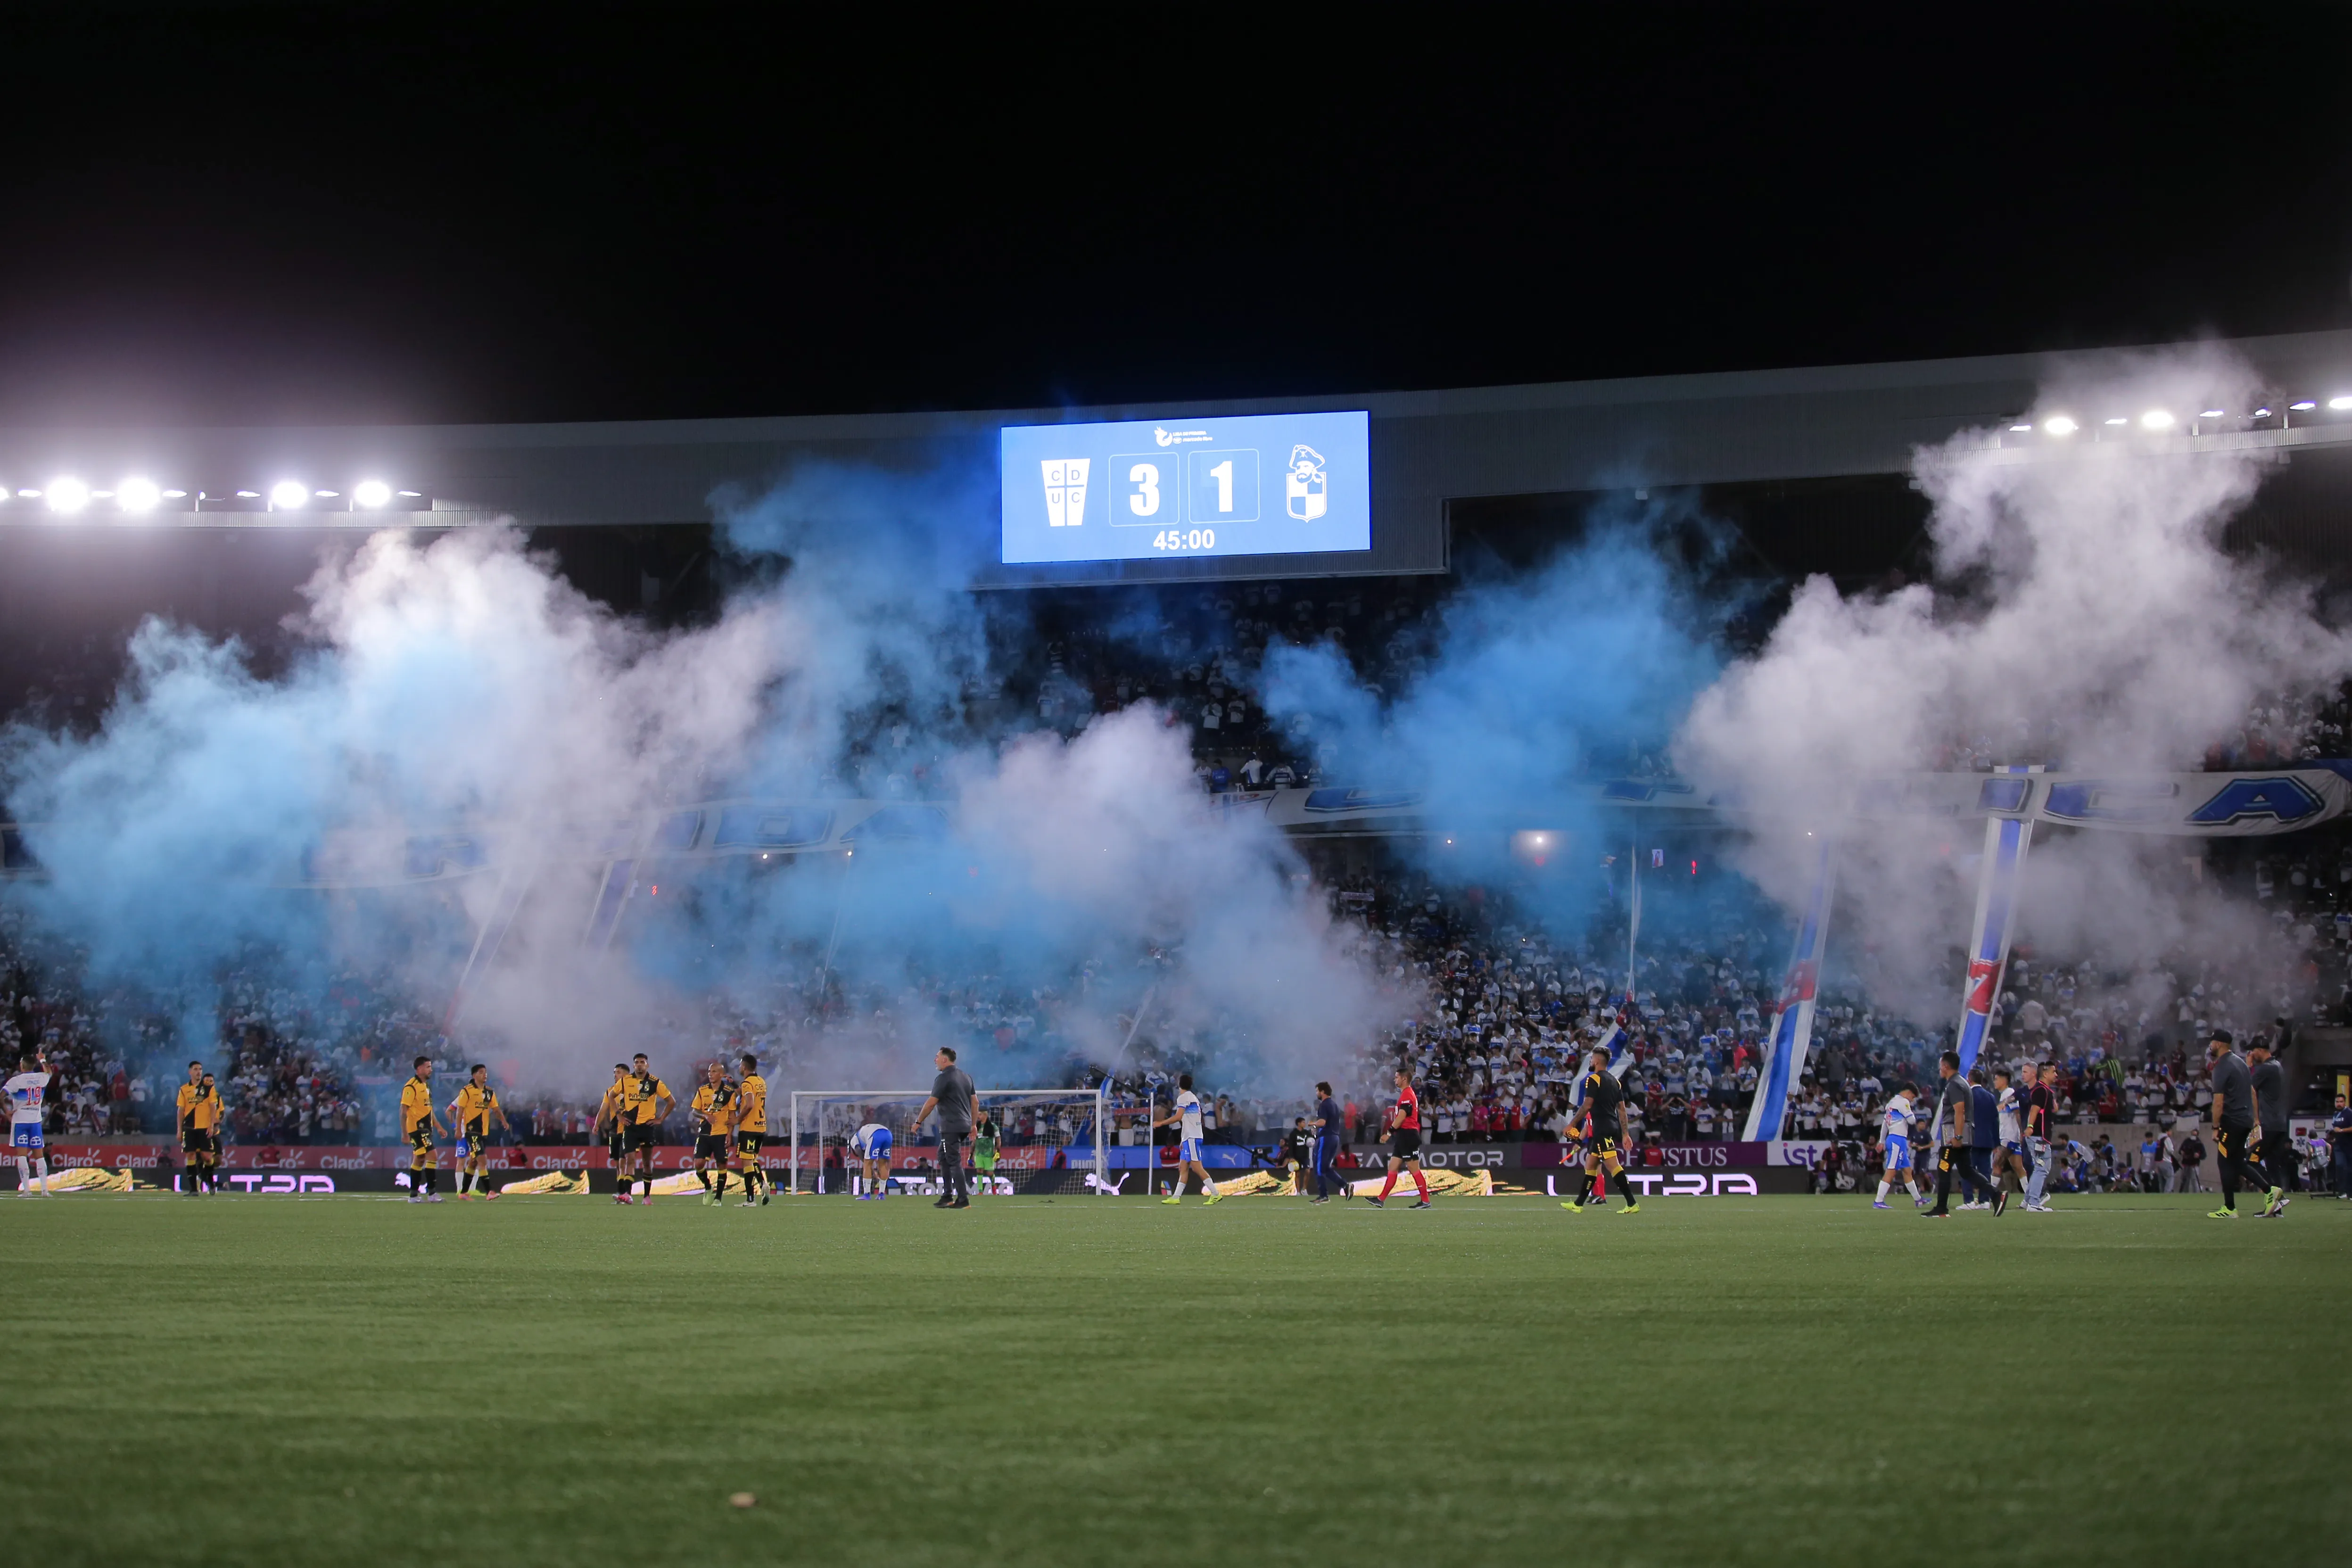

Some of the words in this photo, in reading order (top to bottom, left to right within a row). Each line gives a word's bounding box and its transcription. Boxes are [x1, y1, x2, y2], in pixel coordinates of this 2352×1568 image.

[1130, 463, 1160, 516] 3
[1210, 461, 1233, 512] 1
[1153, 529, 1215, 550] 45:00
[26, 1086, 41, 1106] 19
[52, 1155, 94, 1167] Claro
[321, 1155, 365, 1170] Claro
[533, 1156, 579, 1169] Claro
